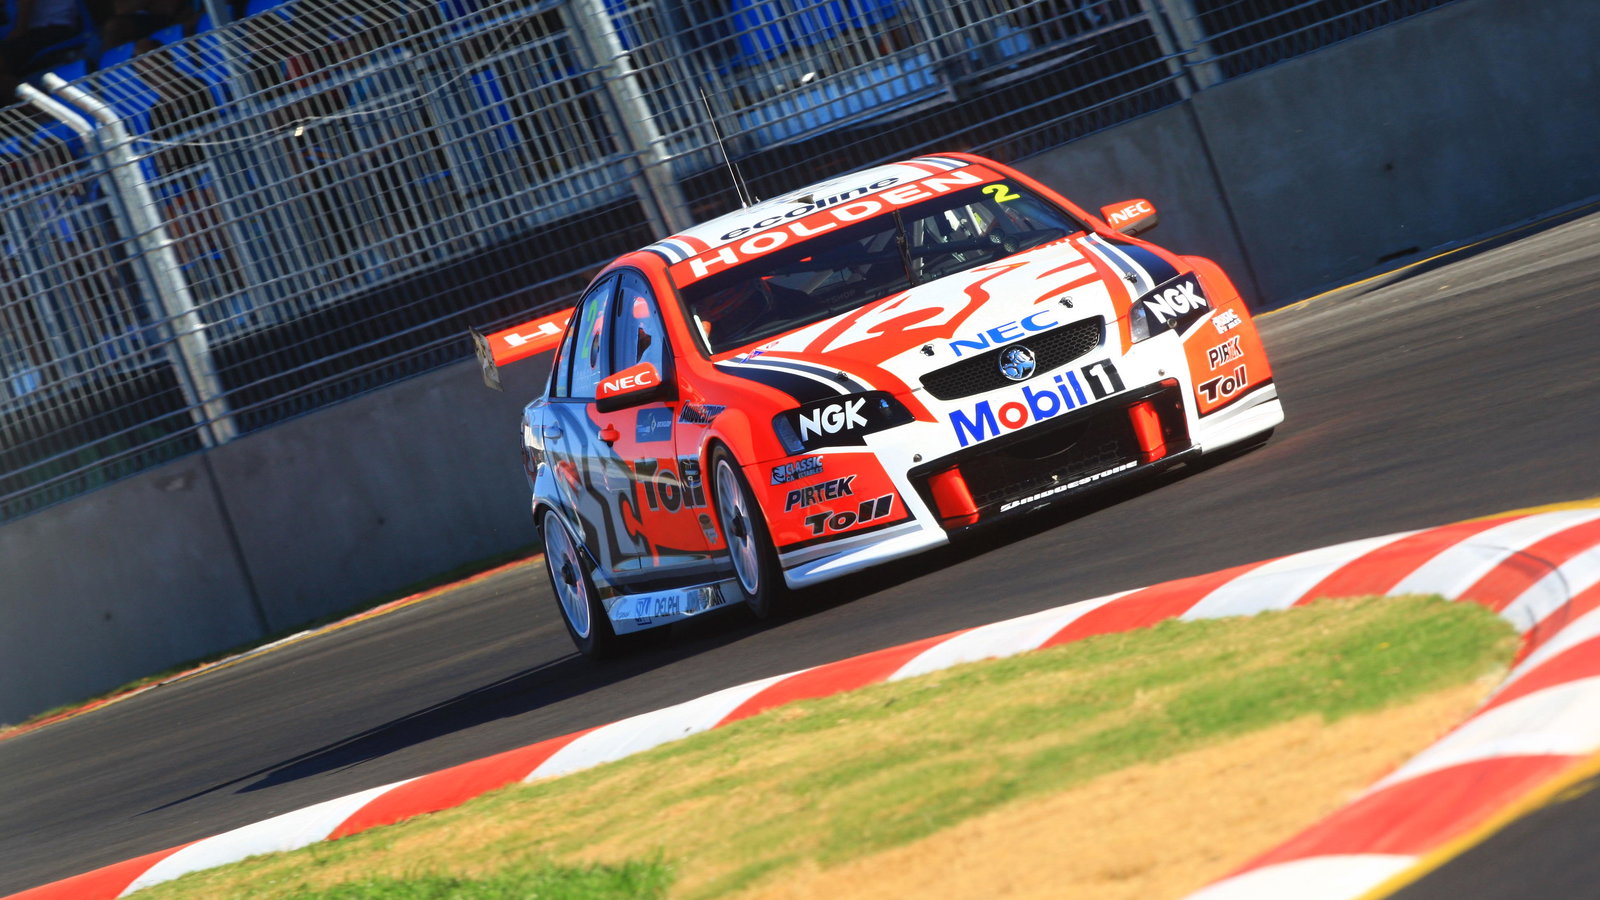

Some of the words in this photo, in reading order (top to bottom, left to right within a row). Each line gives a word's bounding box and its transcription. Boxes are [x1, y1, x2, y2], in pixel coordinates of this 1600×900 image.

[720, 177, 899, 240] ecoline
[982, 183, 1021, 203] 2
[1110, 201, 1151, 225] NEC
[689, 170, 983, 277] HOLDEN
[1143, 280, 1207, 324] NGK
[503, 317, 570, 348] H
[950, 310, 1059, 356] NEC
[603, 371, 652, 393] NEC
[949, 371, 1088, 447] Mobil
[1086, 360, 1120, 399] 1
[1198, 364, 1248, 404] Toll
[800, 398, 868, 441] NGK
[634, 456, 707, 513] Toll
[785, 456, 824, 474] CLASSIC
[784, 474, 857, 513] PIRTEK
[804, 493, 894, 536] Toll
